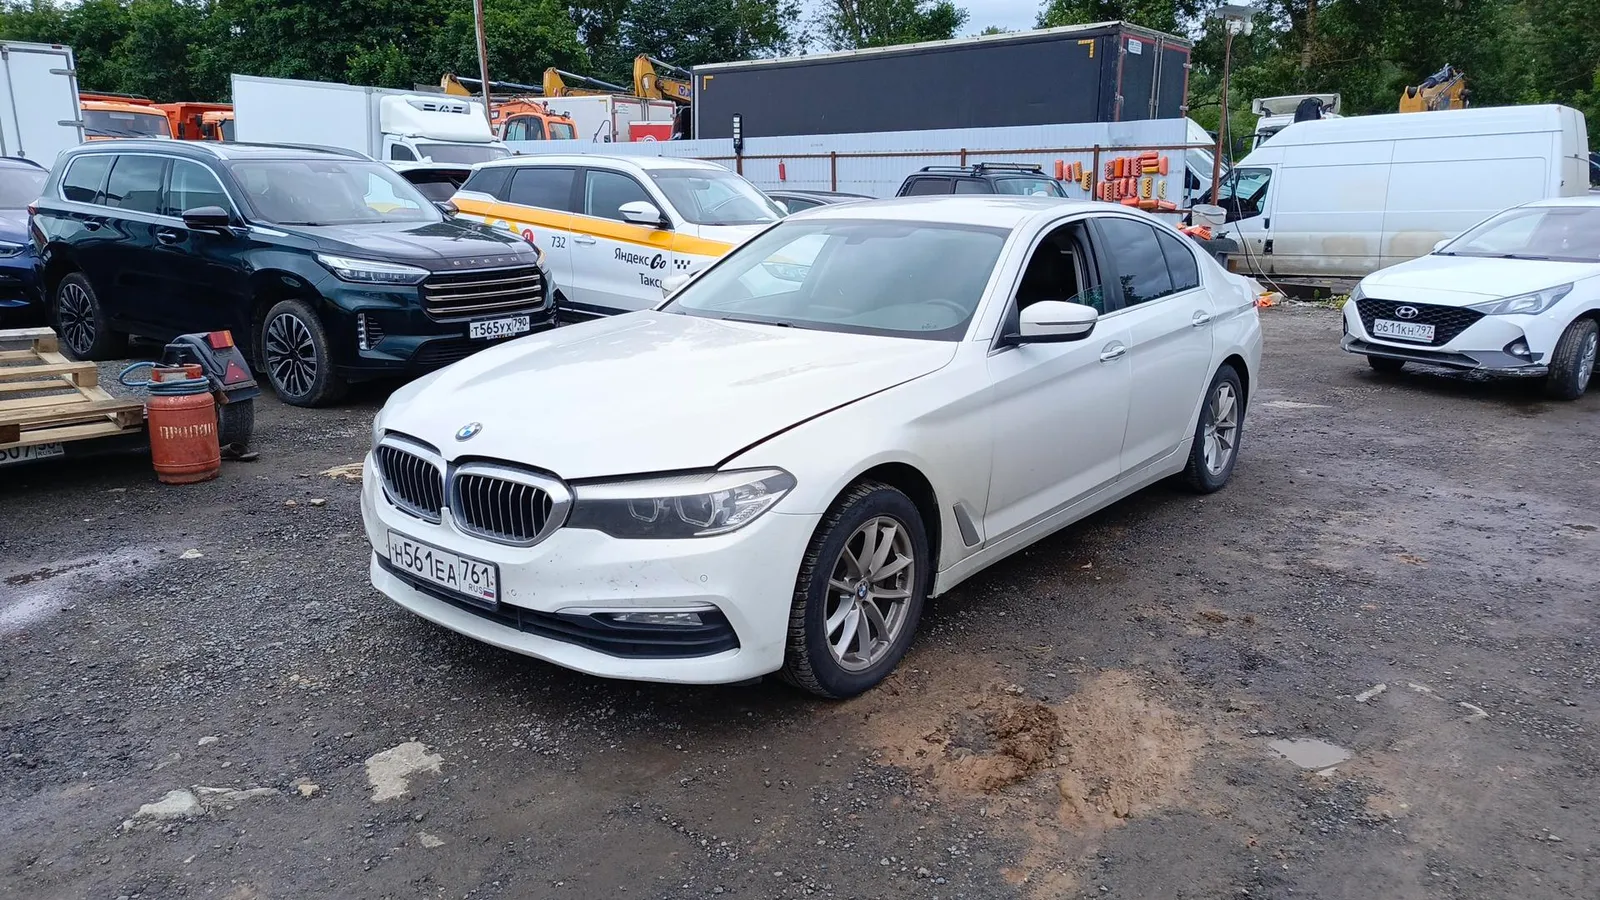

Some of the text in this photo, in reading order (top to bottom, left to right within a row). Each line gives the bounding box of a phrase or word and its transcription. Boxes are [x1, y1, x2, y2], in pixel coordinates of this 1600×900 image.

[551, 235, 566, 249] 732
[614, 247, 667, 270] Яндекс Go
[473, 321, 512, 337] Т565УХ
[513, 317, 527, 328] 790
[1376, 321, 1432, 336] О611КН 797
[394, 541, 490, 588] Н561ЕА 761
[468, 583, 483, 595] RUS
